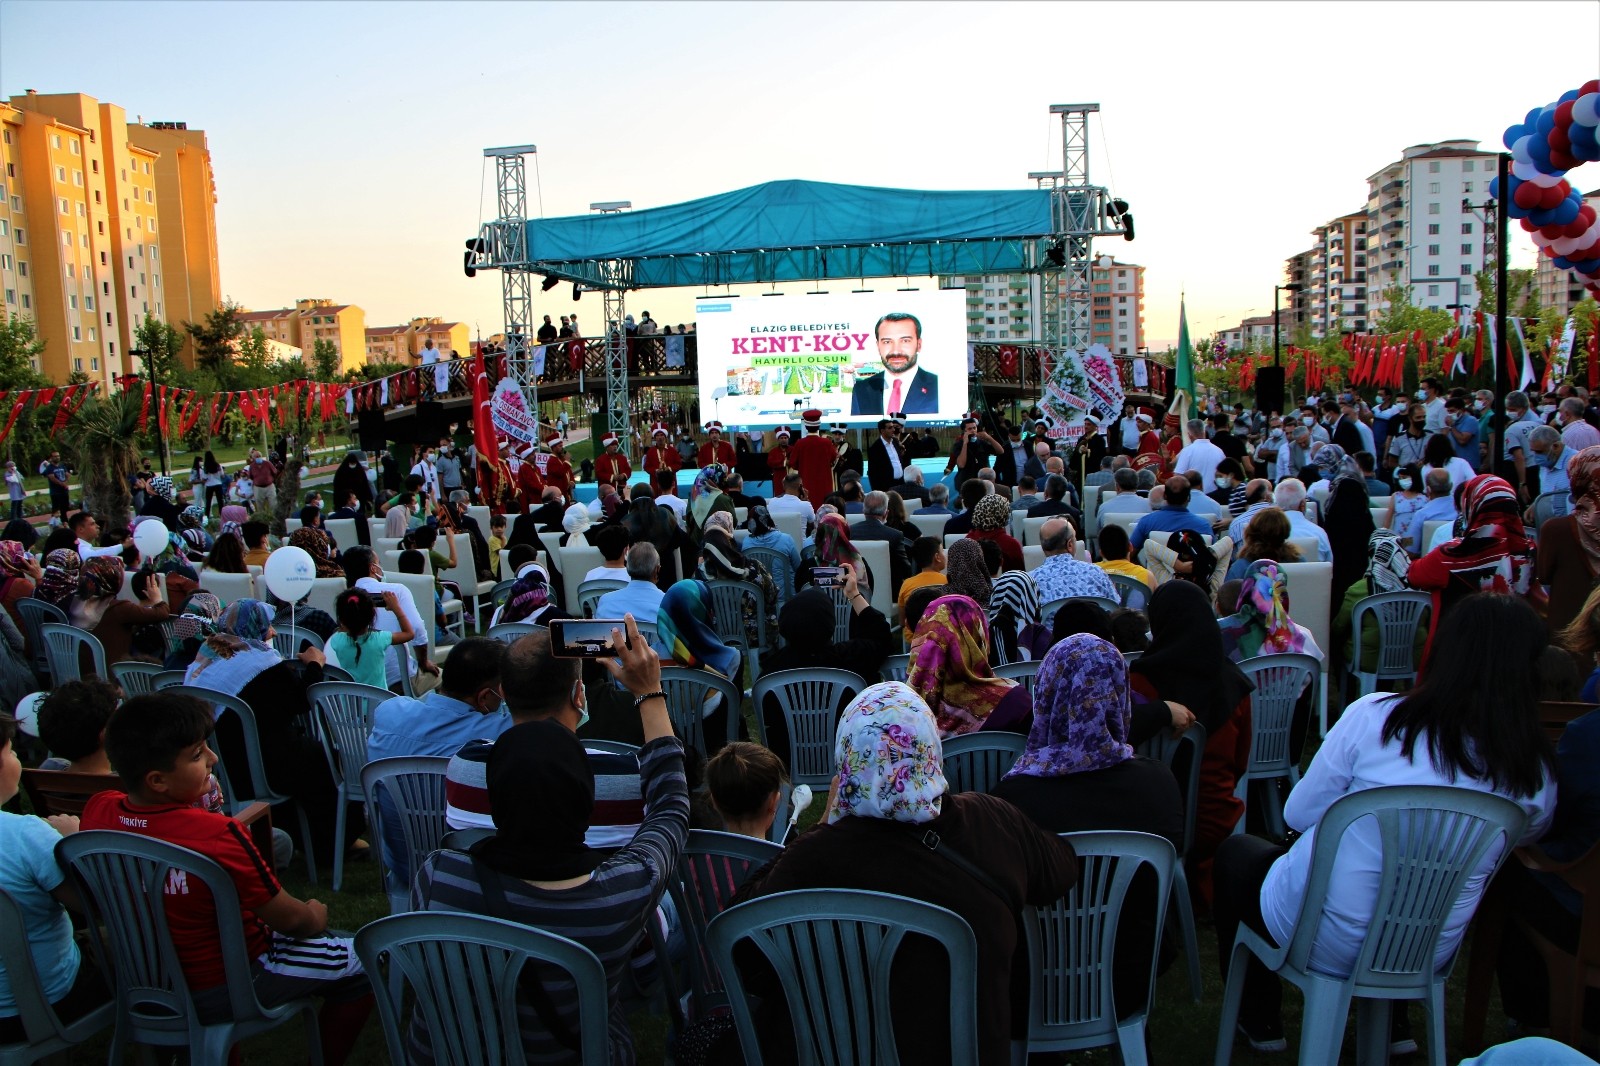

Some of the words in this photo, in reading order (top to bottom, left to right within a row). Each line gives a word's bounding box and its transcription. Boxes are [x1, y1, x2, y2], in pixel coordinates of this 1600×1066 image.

[731, 333, 870, 354] KENT-KÖY
[755, 357, 802, 365] HAYIRLI
[499, 402, 519, 418] OSMAN
[119, 815, 148, 828] TÜRKİYE
